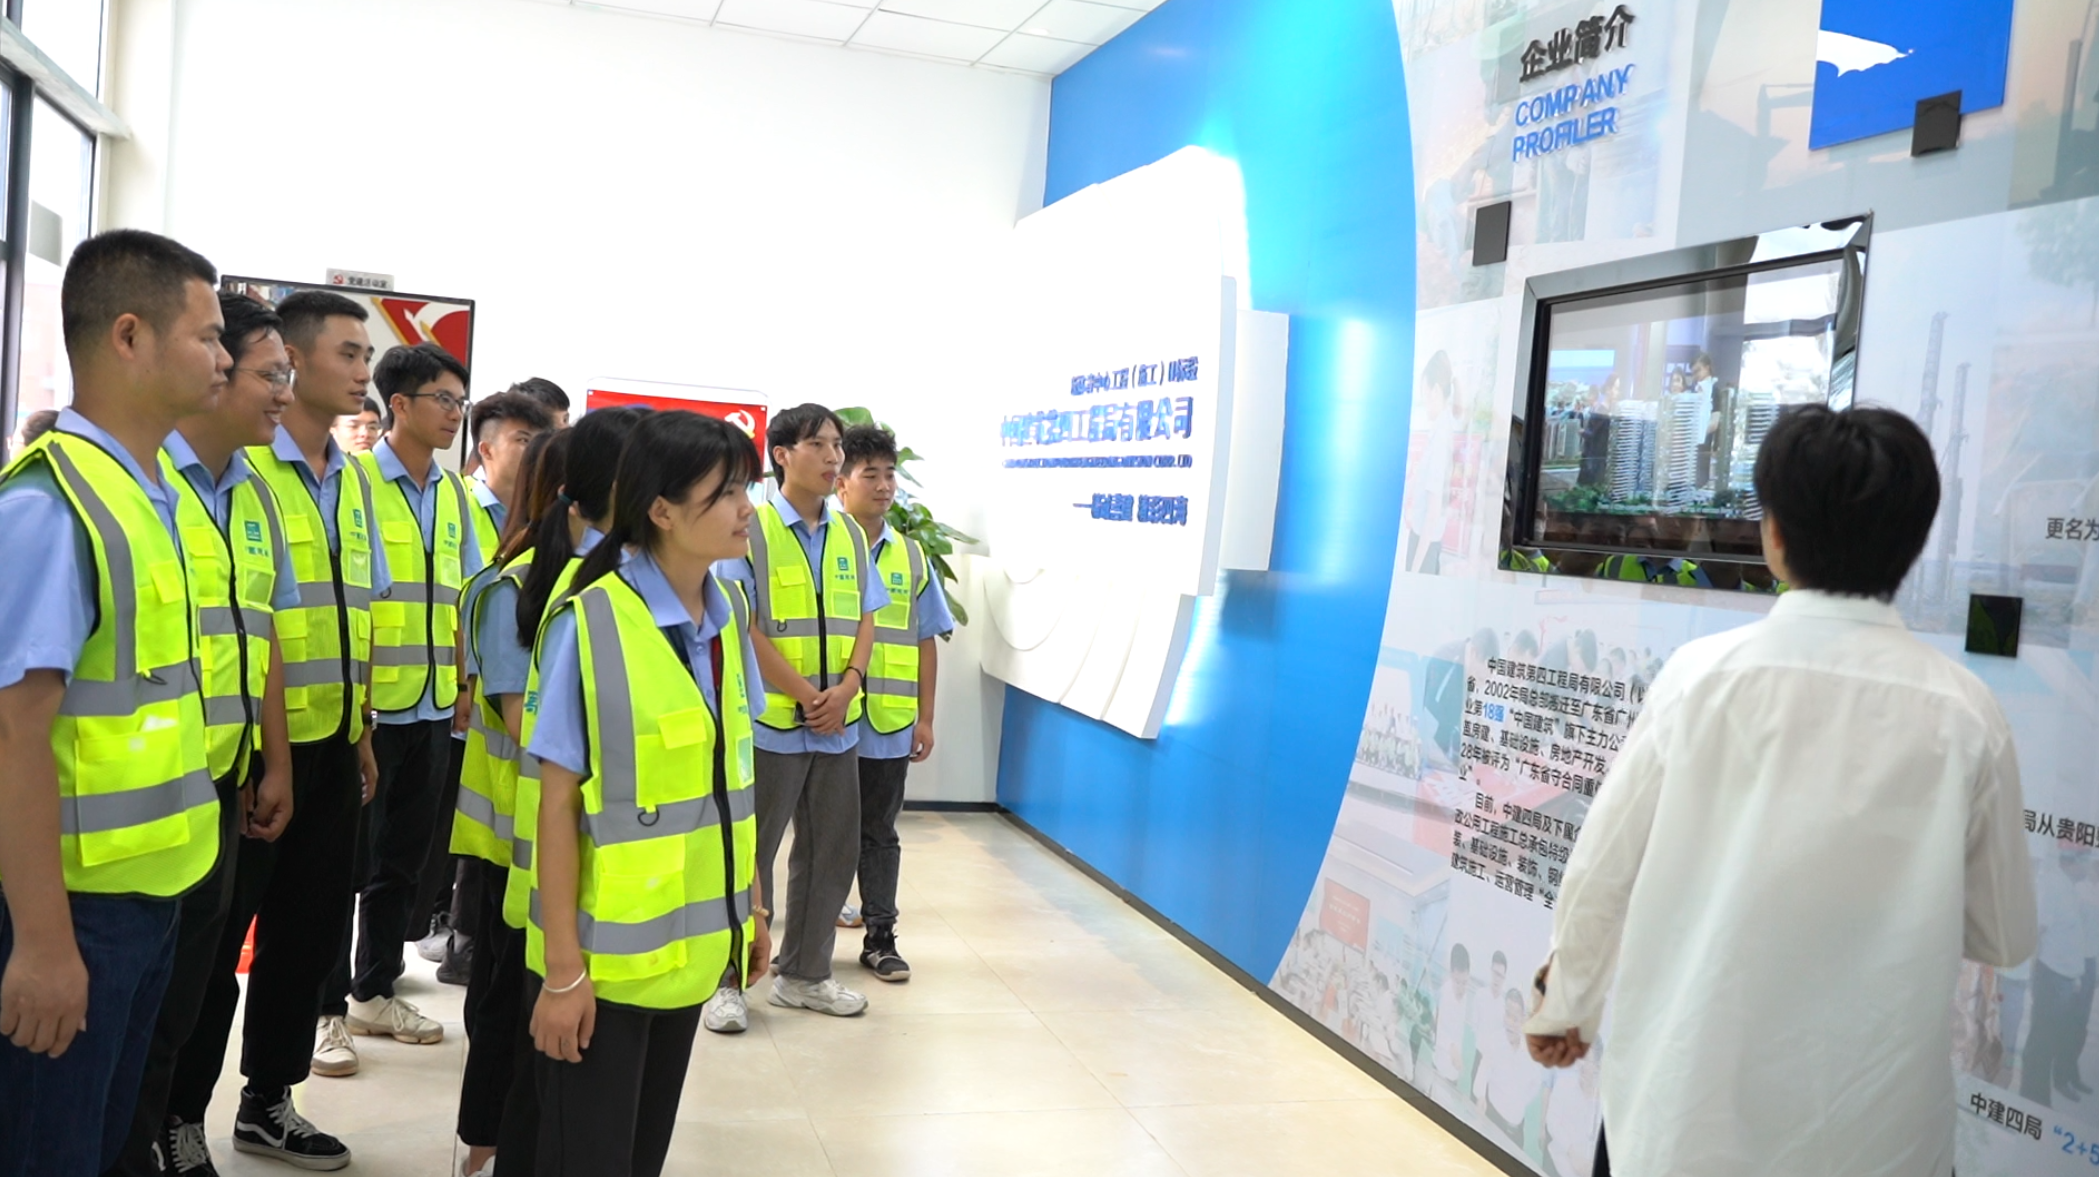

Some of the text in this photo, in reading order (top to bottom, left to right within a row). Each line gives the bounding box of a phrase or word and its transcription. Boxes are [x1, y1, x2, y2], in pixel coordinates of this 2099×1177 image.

[1520, 4, 1636, 83] 企业简介
[1515, 63, 1636, 127] COMPANY
[1512, 107, 1618, 162] PROFILER
[2045, 517, 2099, 541] 更名为
[2023, 809, 2099, 848] 局从贵阳
[1970, 1092, 2043, 1141] 中建四局
